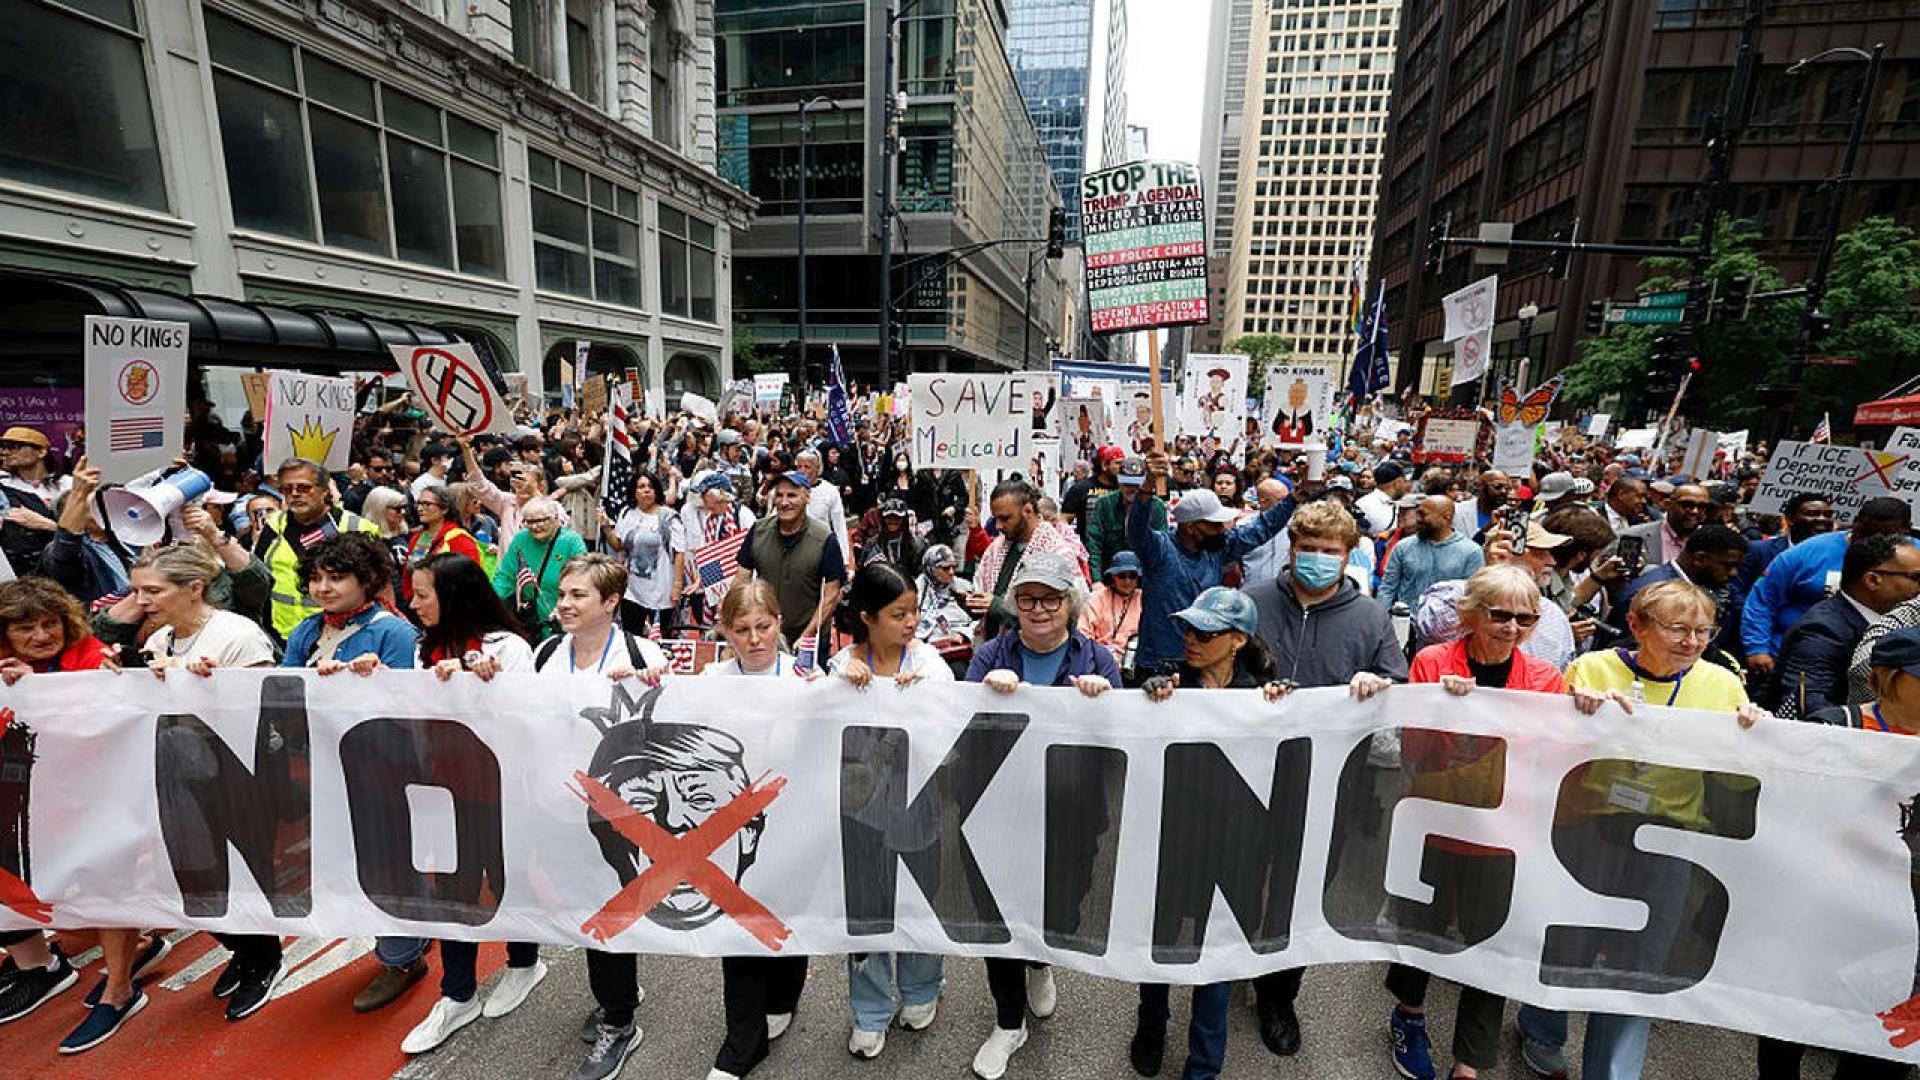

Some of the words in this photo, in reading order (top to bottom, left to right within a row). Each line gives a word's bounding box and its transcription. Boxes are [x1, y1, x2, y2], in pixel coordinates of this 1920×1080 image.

[1084, 165, 1144, 199] STOP
[1152, 164, 1196, 187] THE
[1083, 192, 1131, 214] TRUMP
[1137, 185, 1200, 205] AGENDA!
[1083, 209, 1132, 226] DEFEND
[1154, 200, 1203, 215] EXPAND
[1083, 217, 1153, 235] IMMIGRANT
[1160, 210, 1204, 223] RIGHTS
[1086, 254, 1116, 268] STOP
[1120, 248, 1160, 262] POLICE
[1164, 242, 1204, 256] CRIMES
[1087, 264, 1129, 279] DEFEND
[1184, 257, 1205, 268] AND
[1088, 272, 1166, 289] REPRODUCTIVE
[1169, 268, 1205, 280] RIGHTS
[1091, 307, 1132, 322] DEFEND
[1136, 301, 1195, 315] EDUCATION
[1092, 314, 1151, 331] ACADEMIC
[1156, 309, 1207, 322] FREEDOM
[93, 323, 124, 346] NO
[131, 324, 183, 348] KINGS
[1273, 367, 1289, 375] NO
[1292, 367, 1324, 376] KINGS
[316, 383, 353, 411] KINGS
[925, 378, 1026, 417] SAVE
[917, 423, 1019, 465] Medicaid
[1793, 443, 1811, 457] If
[1817, 446, 1851, 464] ICE
[1775, 457, 1861, 478] Deported
[1779, 472, 1860, 496] Criminals,
[154, 674, 506, 927] NO
[841, 712, 1761, 995] KINGS
